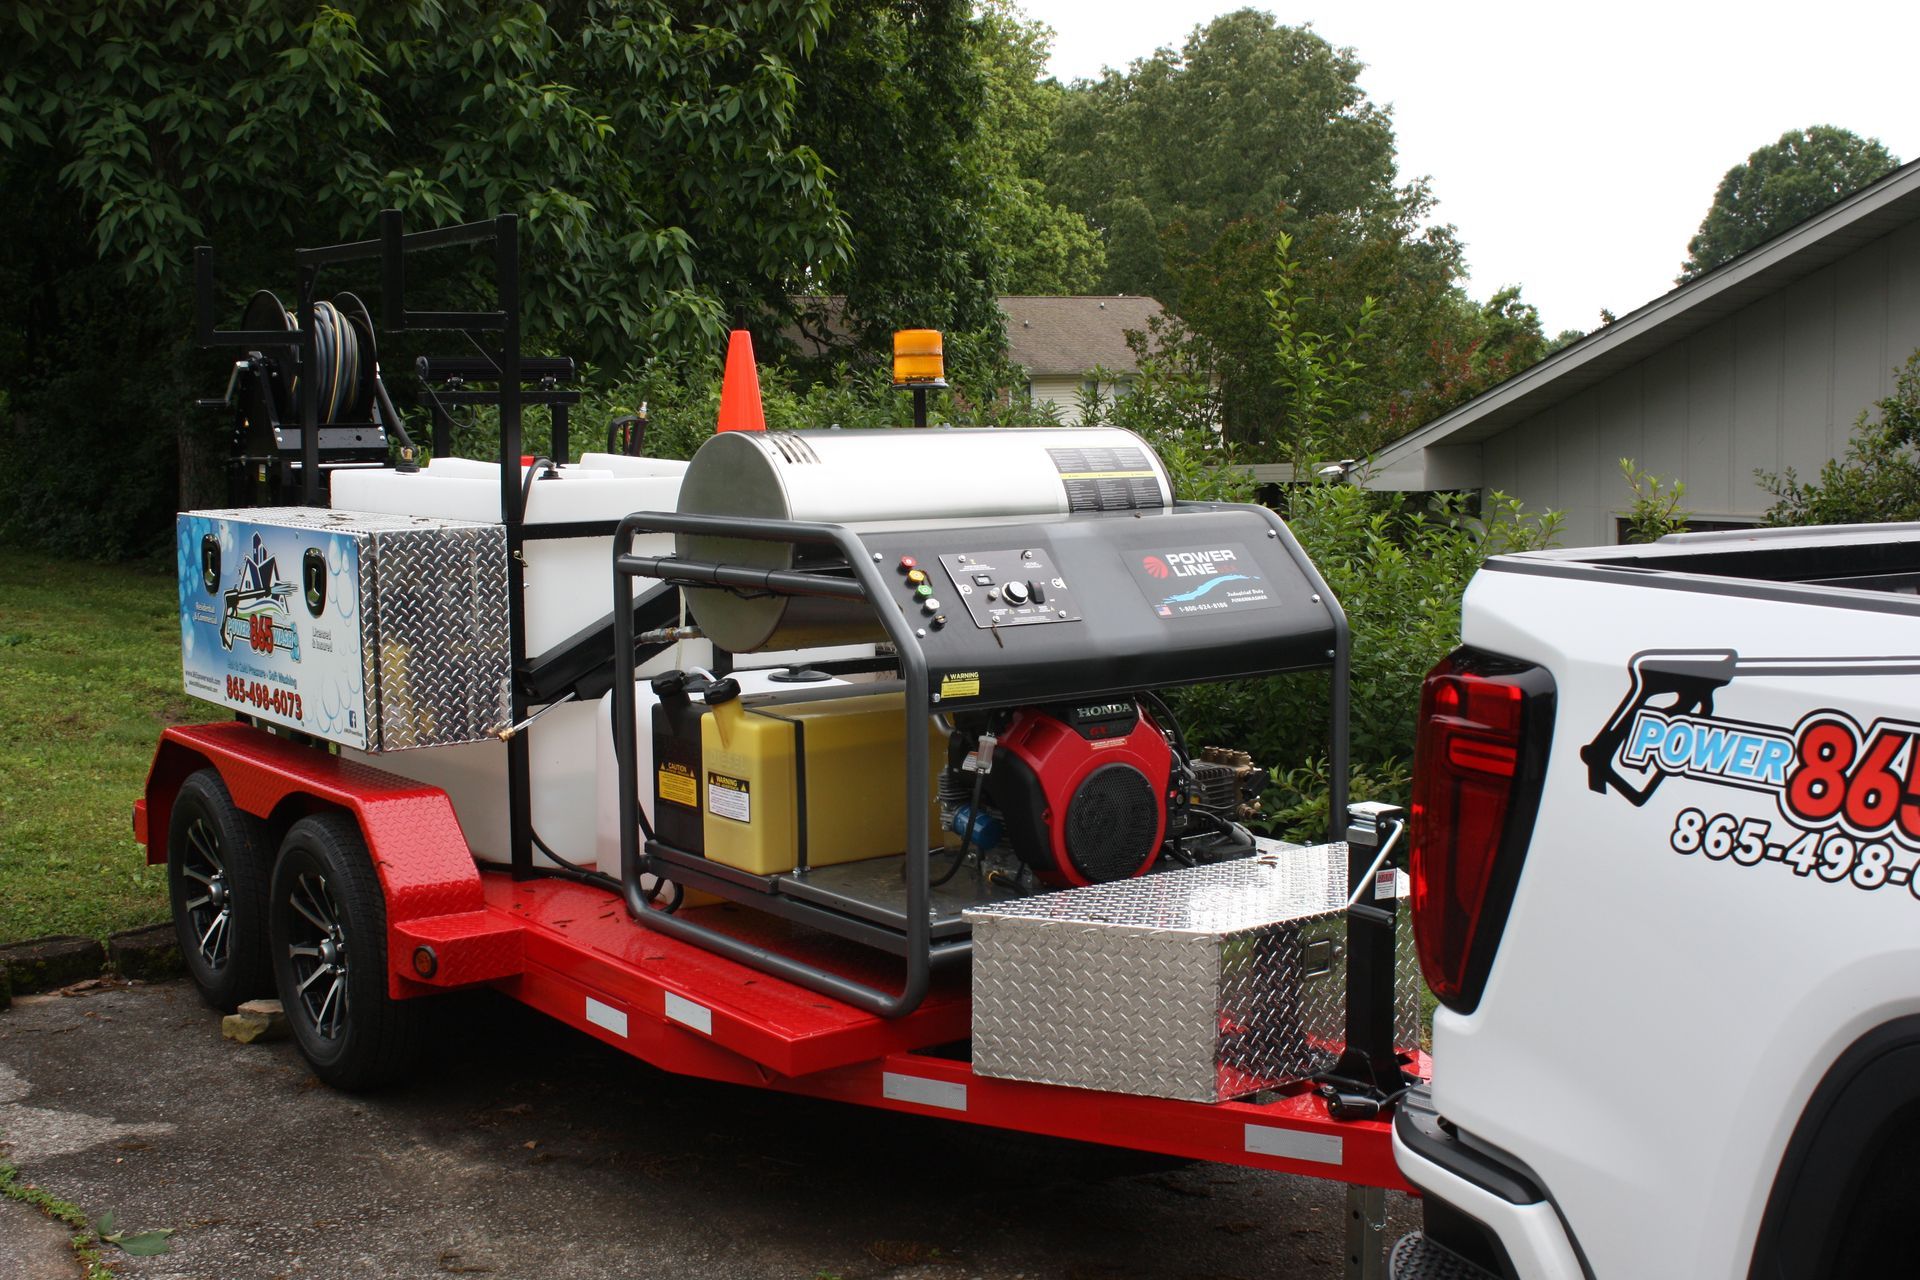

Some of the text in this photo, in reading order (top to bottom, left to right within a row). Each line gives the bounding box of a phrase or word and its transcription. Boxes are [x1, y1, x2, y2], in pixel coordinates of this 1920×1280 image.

[1165, 549, 1237, 565] POWER
[1172, 562, 1218, 577] LINE
[227, 613, 294, 654] POWER 865 WASH
[950, 671, 979, 680] WARNING
[226, 674, 302, 721] 865-498-6073
[1077, 703, 1133, 718] HONDA
[1630, 717, 1793, 785] POWER
[668, 761, 687, 773] CAUTION
[716, 775, 738, 787] WARNING
[1670, 807, 1920, 902] 865-498-
